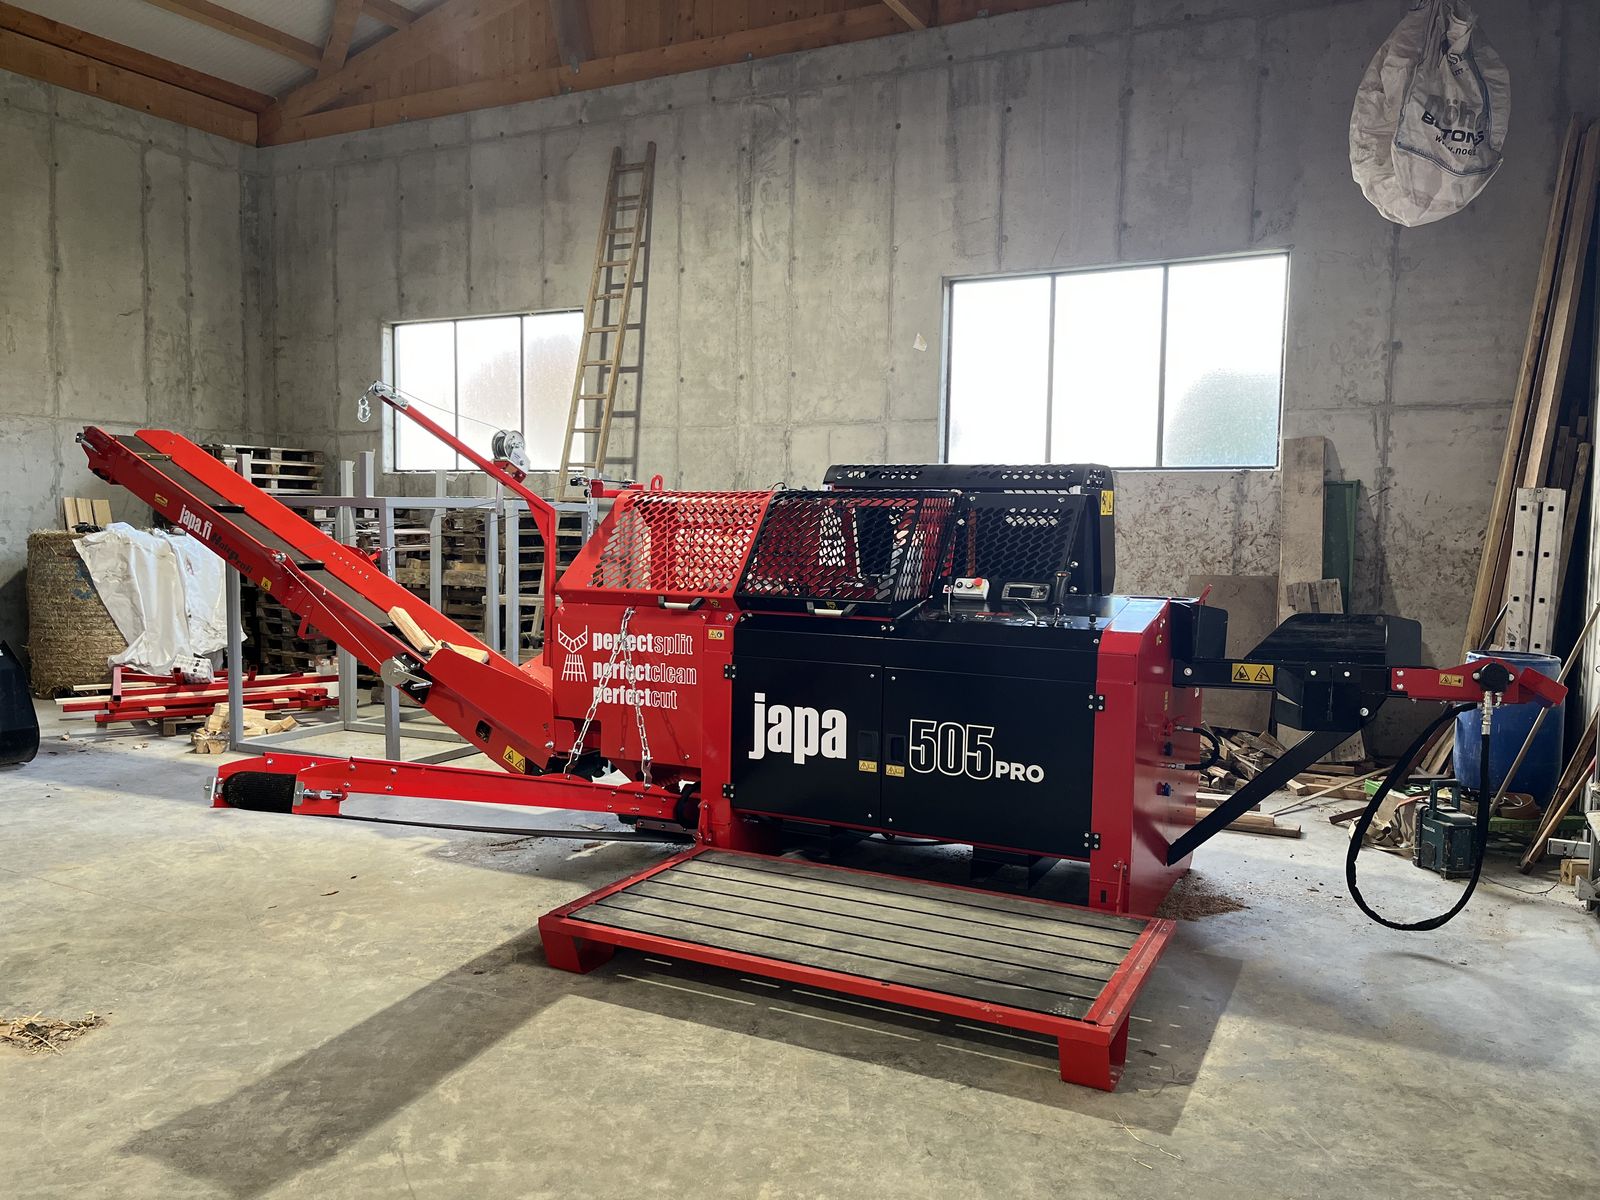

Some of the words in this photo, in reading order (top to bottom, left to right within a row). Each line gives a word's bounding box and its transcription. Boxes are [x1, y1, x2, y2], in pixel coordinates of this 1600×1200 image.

[178, 504, 213, 541] japa.fi
[748, 692, 847, 765] japa
[909, 718, 995, 780] 505
[995, 760, 1045, 783] PRO
